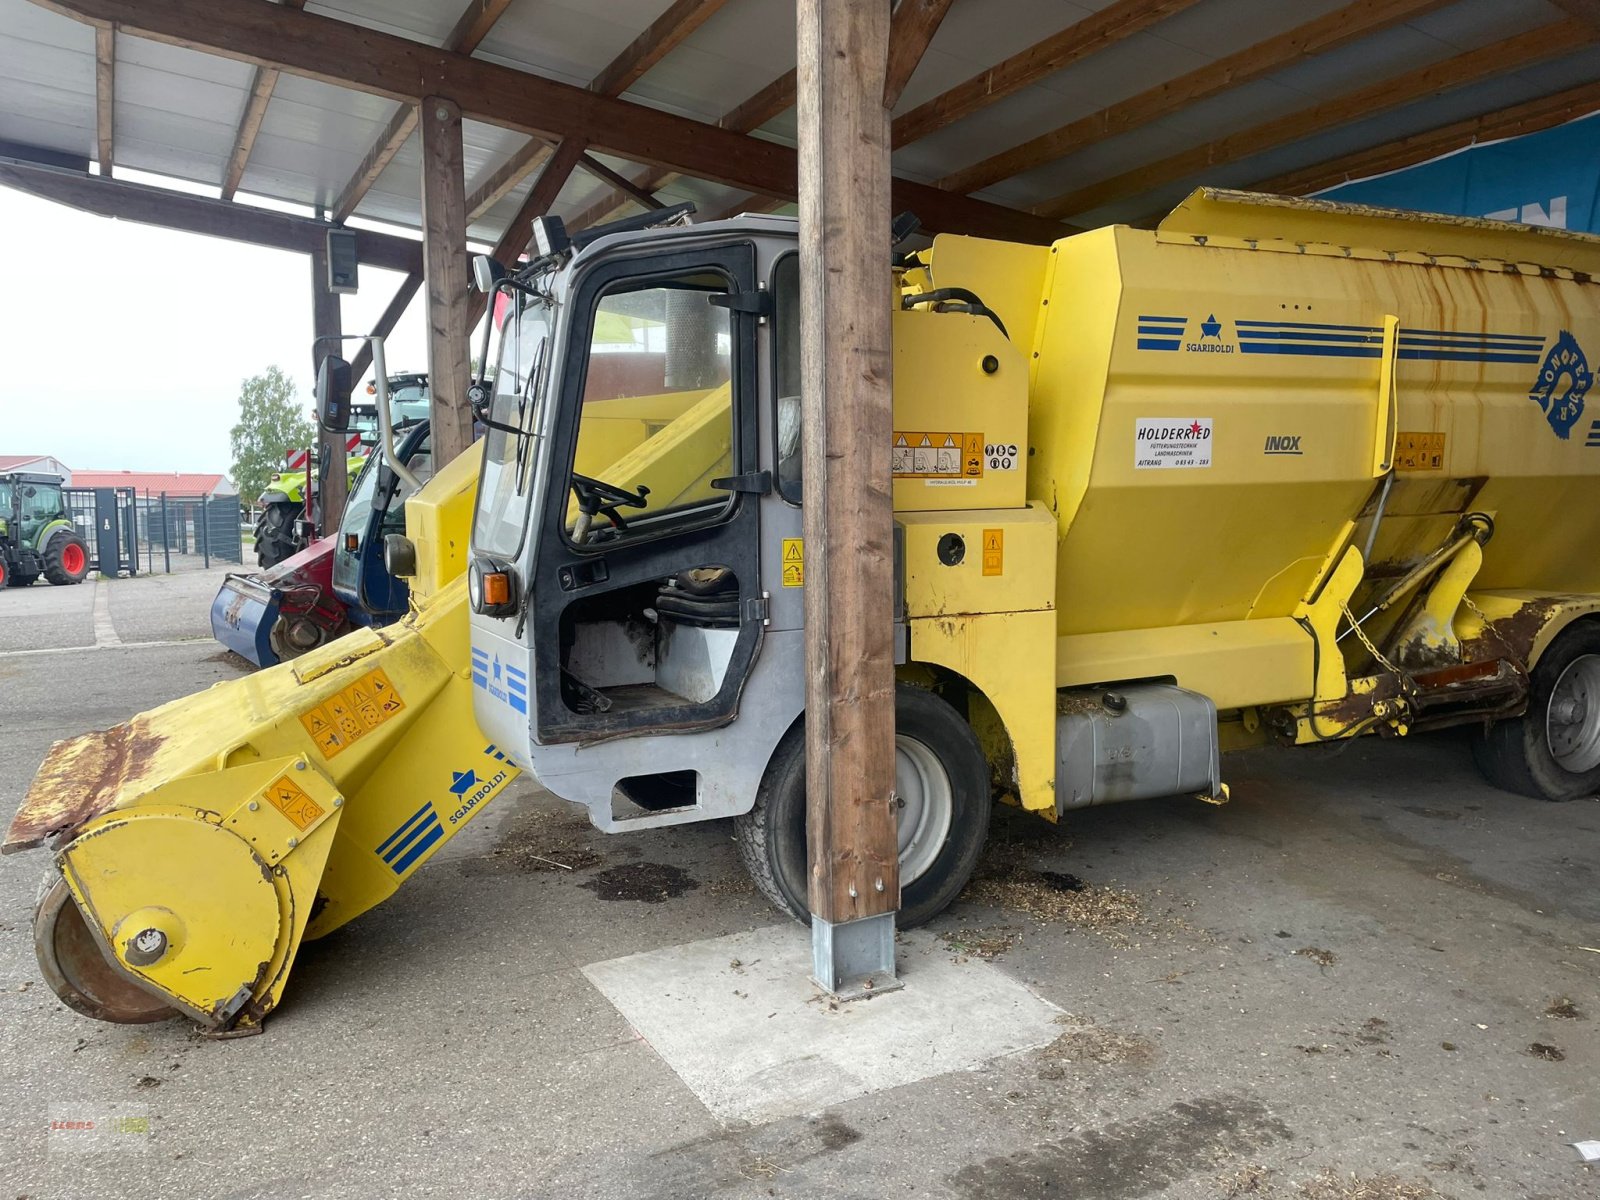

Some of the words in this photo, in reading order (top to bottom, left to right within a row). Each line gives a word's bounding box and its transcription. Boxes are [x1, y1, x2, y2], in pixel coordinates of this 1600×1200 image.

[1186, 343, 1235, 354] SGARIBOLDI
[1538, 349, 1587, 421] MONOFEEDER
[1137, 427, 1211, 440] HOLDERRIED
[1264, 436, 1301, 451] INOX
[449, 770, 507, 824] SGARIBOLDI
